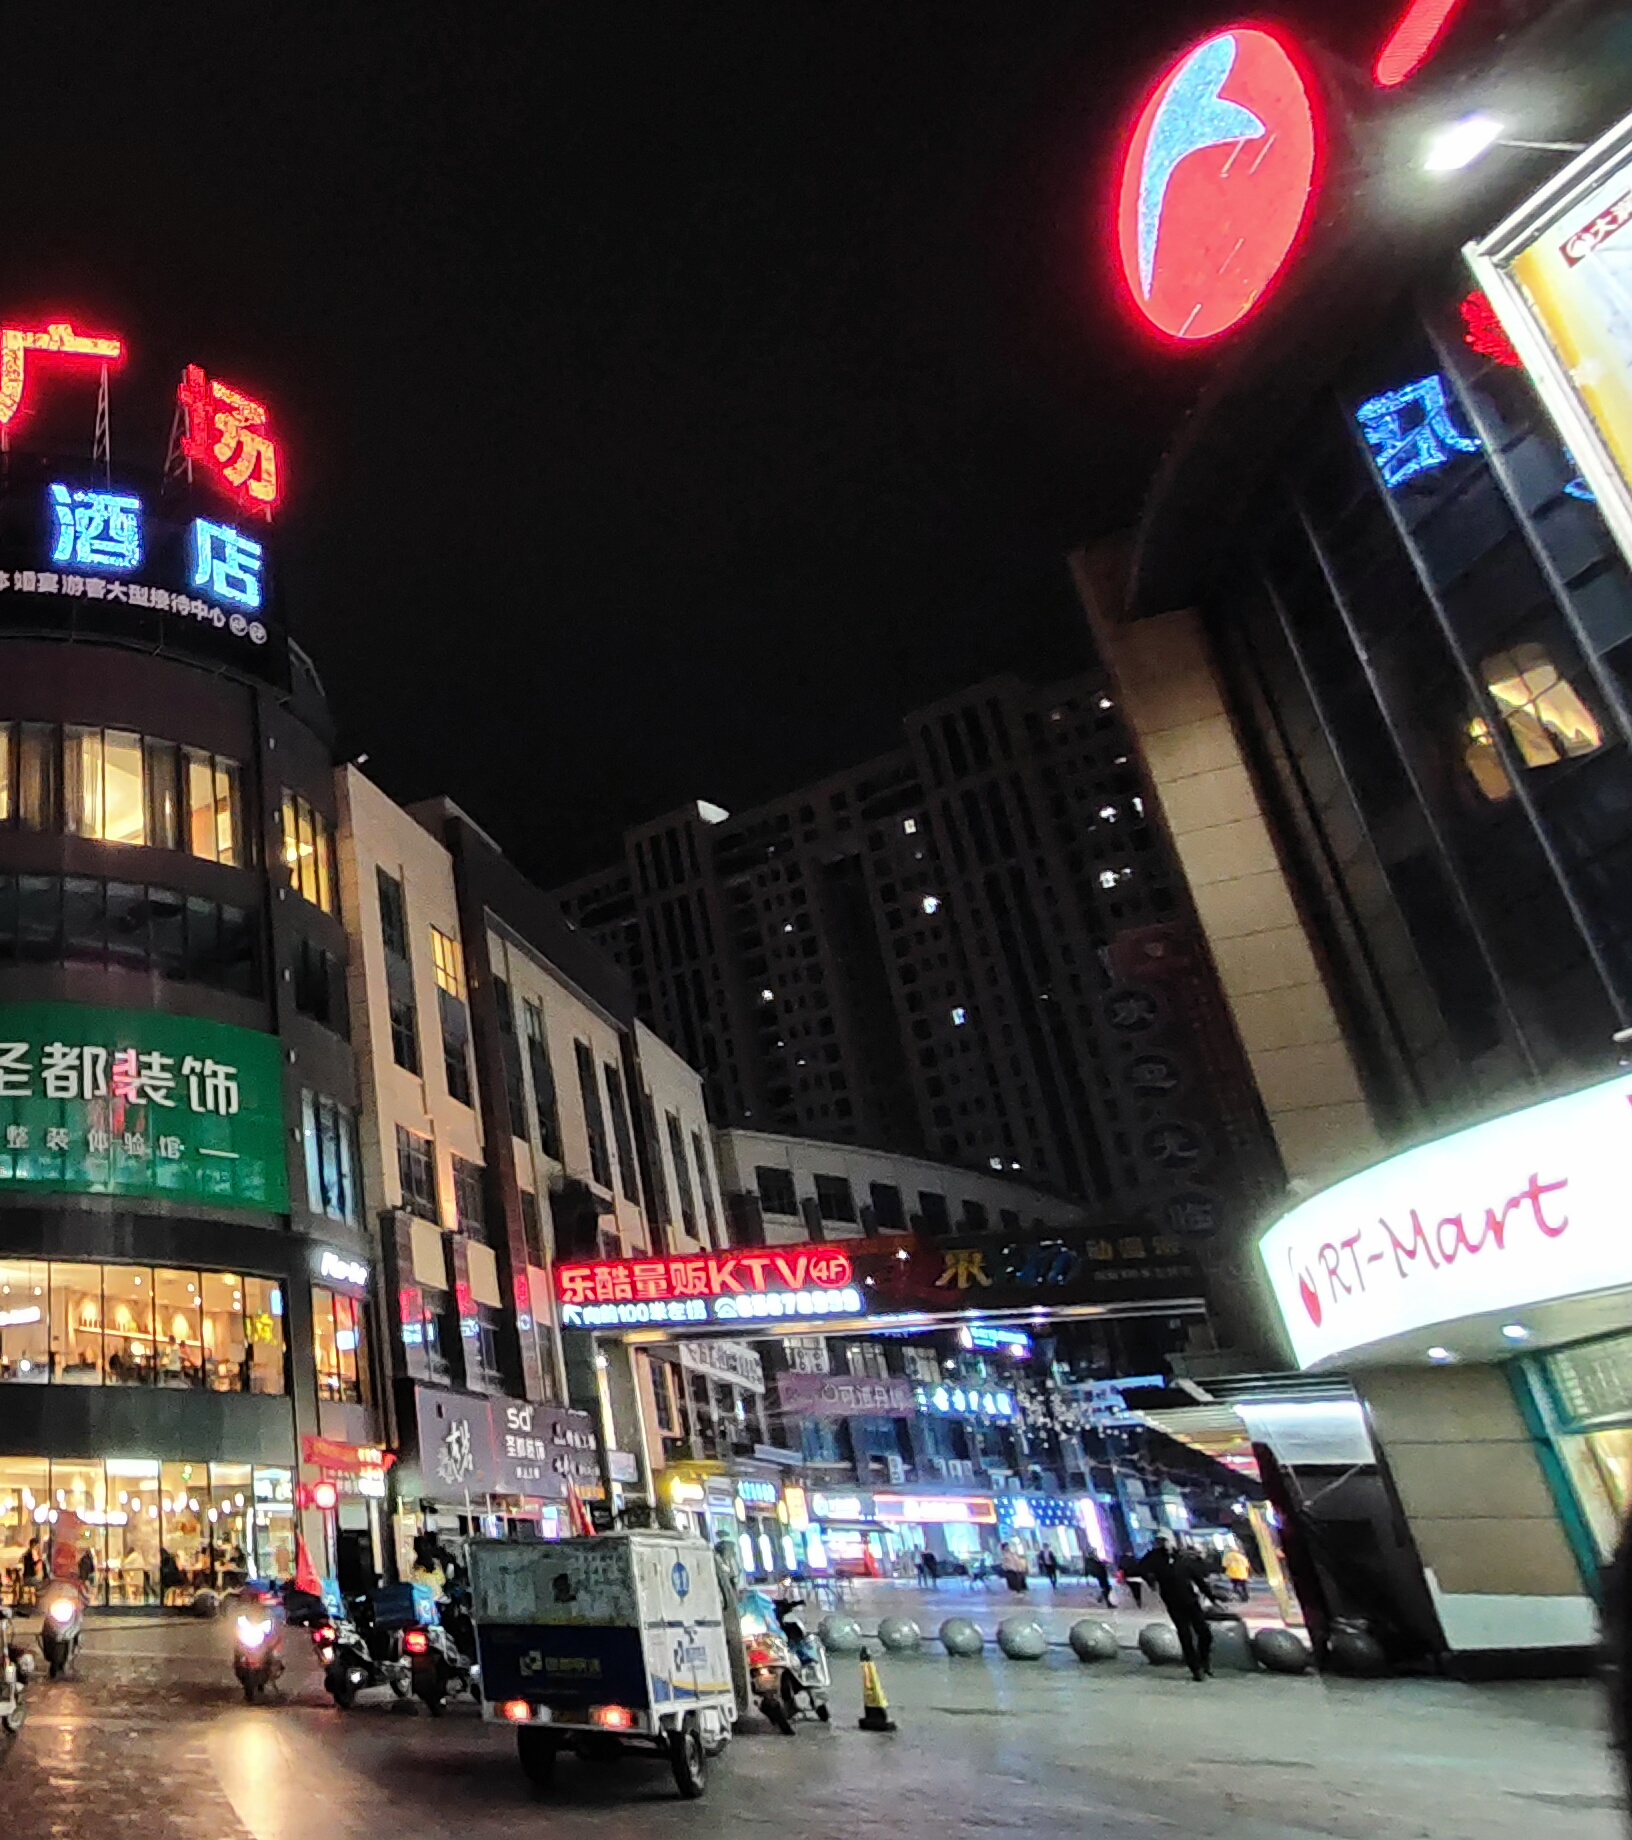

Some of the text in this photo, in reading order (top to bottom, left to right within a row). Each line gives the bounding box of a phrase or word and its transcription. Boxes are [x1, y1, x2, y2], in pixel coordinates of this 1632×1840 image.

[560, 1256, 808, 1303] 乐酷量贩KTV
[1318, 1172, 1569, 1303] RT-Mart
